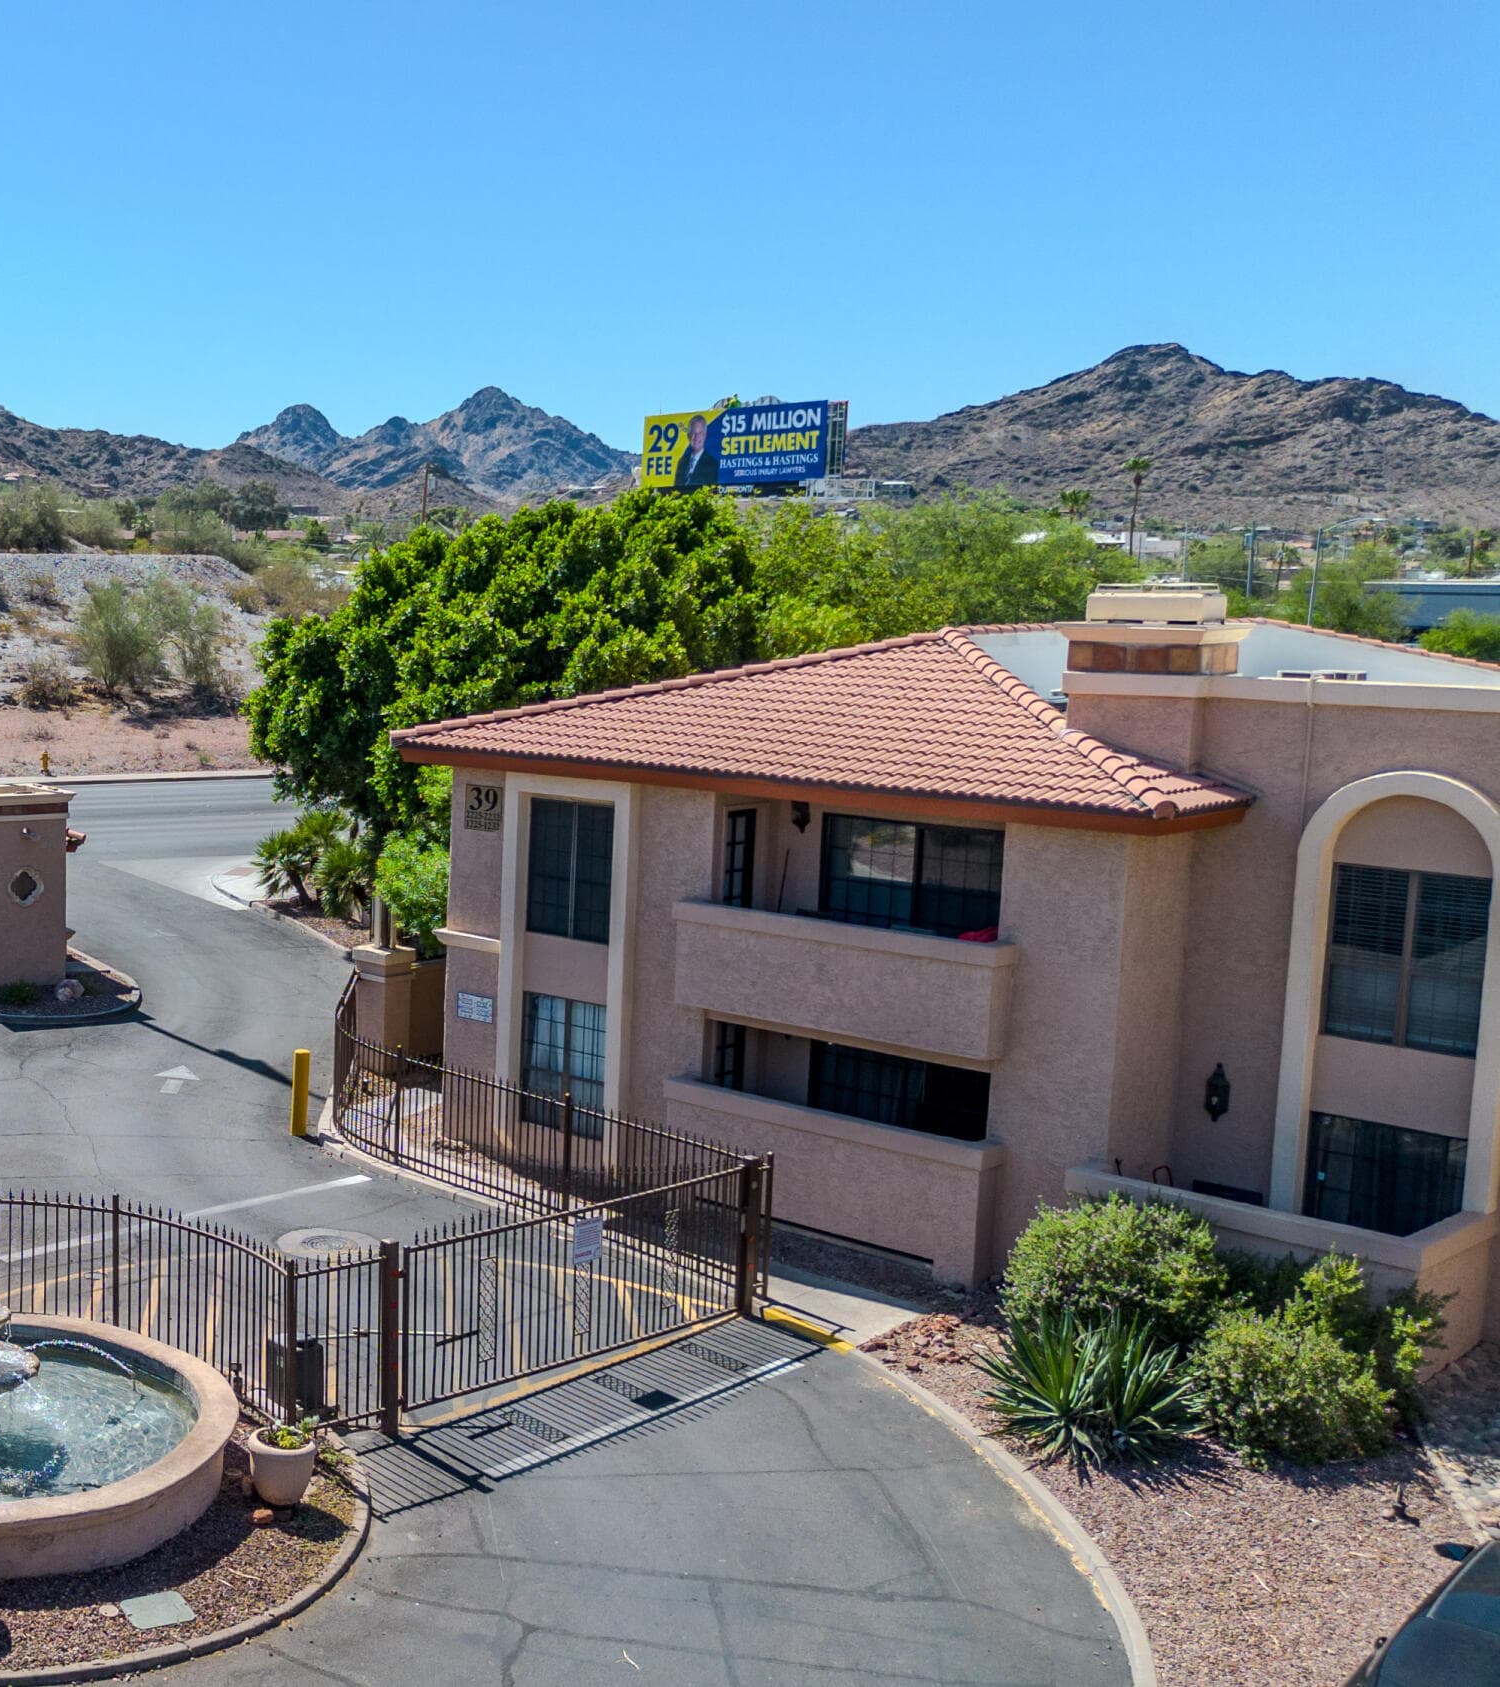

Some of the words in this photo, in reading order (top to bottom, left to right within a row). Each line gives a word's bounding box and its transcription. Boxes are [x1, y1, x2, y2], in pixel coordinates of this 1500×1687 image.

[721, 413, 747, 436] $15
[751, 407, 822, 432] MILLION
[721, 430, 820, 456] SETTLEMENT
[646, 456, 673, 476] FEE
[719, 455, 763, 469] HASTINGS
[764, 456, 772, 466] &
[772, 452, 819, 466] HASTINGS
[469, 786, 498, 812] 39
